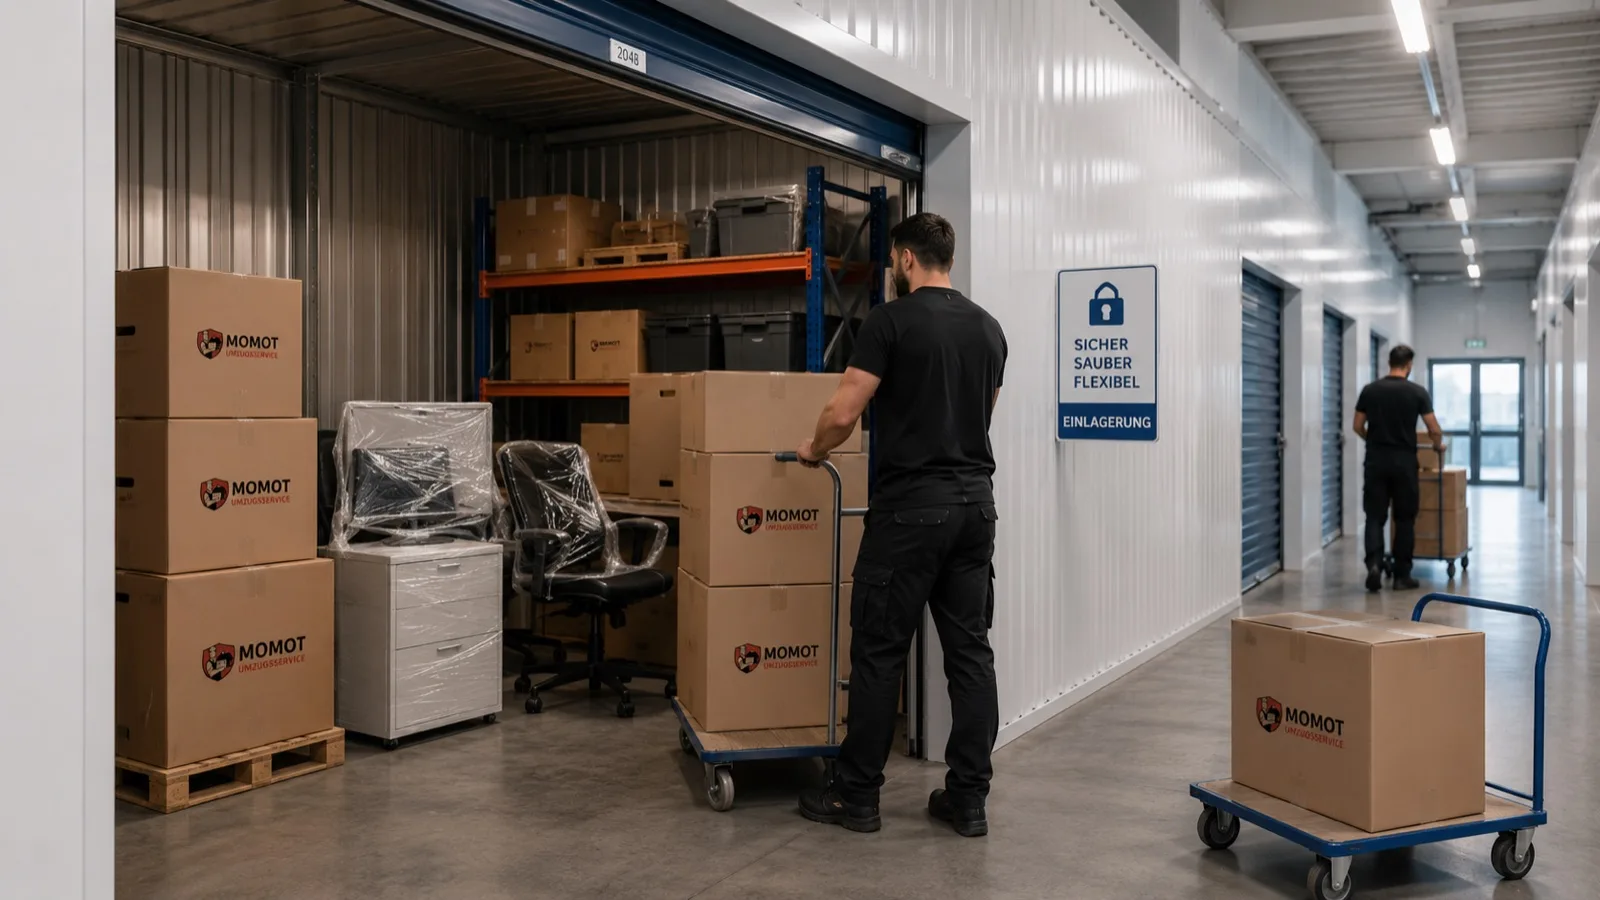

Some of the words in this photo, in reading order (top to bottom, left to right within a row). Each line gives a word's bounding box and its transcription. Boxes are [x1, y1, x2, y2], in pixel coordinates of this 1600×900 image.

[617, 46, 639, 66] 2048
[226, 334, 279, 349] MOMOT
[1074, 338, 1128, 351] SICHER
[1074, 356, 1132, 370] SAUBER
[1074, 375, 1140, 389] FLEXIBEL
[1063, 416, 1151, 428] EINLAGERUNG
[232, 479, 291, 496] MOMOT
[766, 509, 819, 522] MOMOT
[239, 636, 306, 661] MOMOT
[764, 645, 819, 660] MOMOT
[238, 654, 306, 673] UMZUGSSERVICE
[1285, 706, 1345, 736] MOMOT
